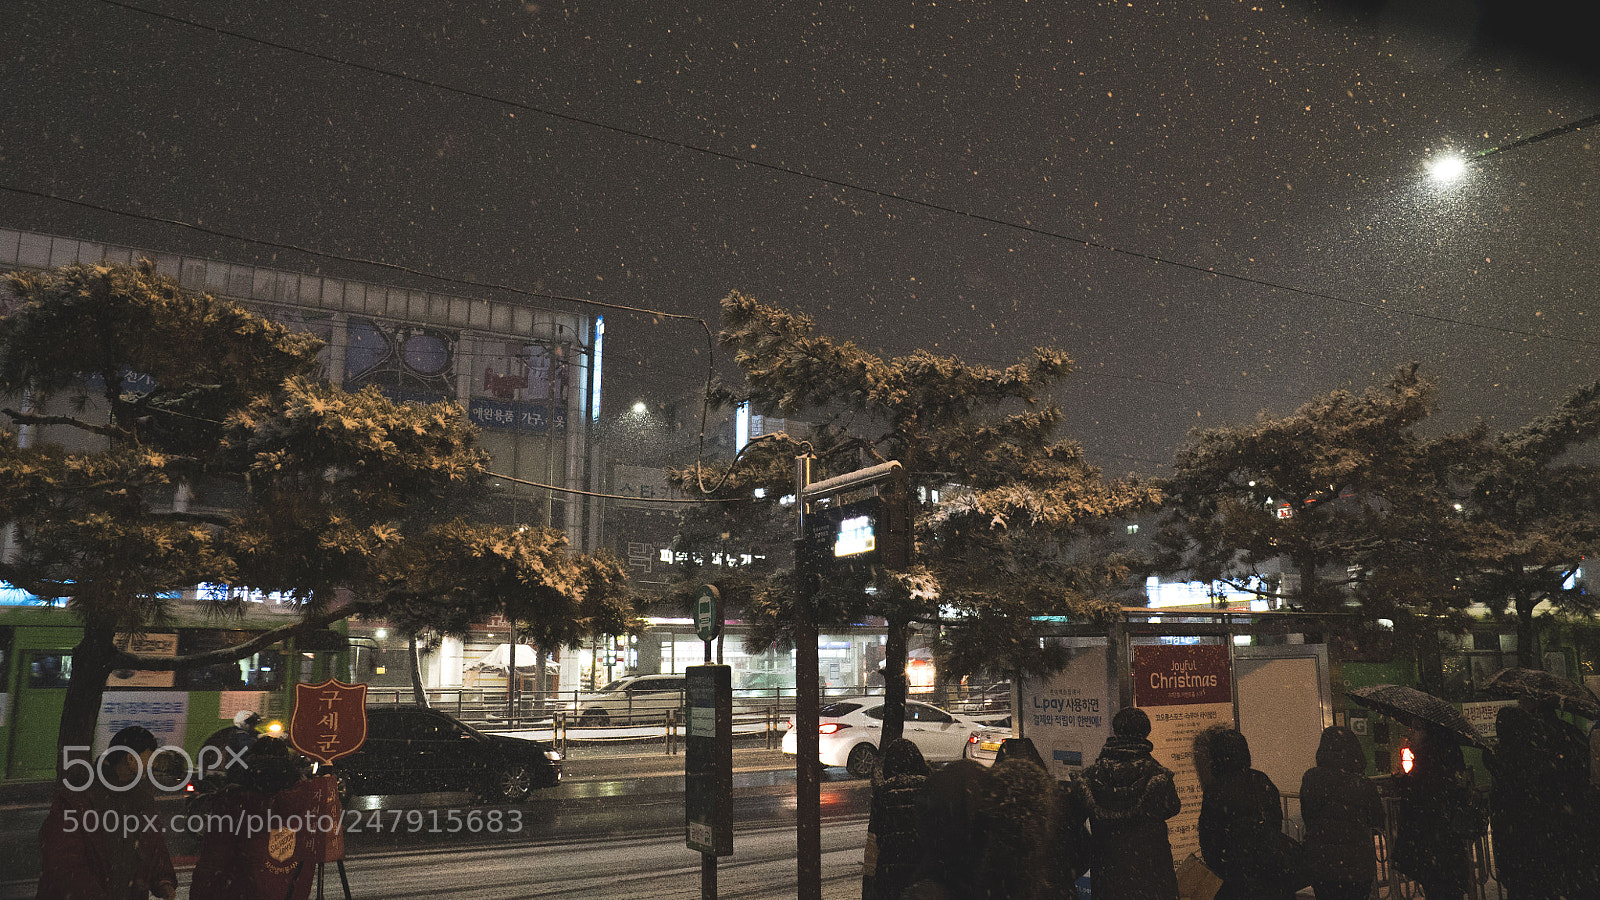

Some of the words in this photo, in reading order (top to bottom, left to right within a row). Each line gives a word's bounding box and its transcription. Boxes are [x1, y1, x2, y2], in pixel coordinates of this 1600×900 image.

[472, 406, 515, 422] 애완용품
[1170, 660, 1198, 674] Joyful
[1150, 672, 1217, 689] Christmas
[1066, 698, 1099, 712] 사용하면
[316, 690, 342, 752] 구세군
